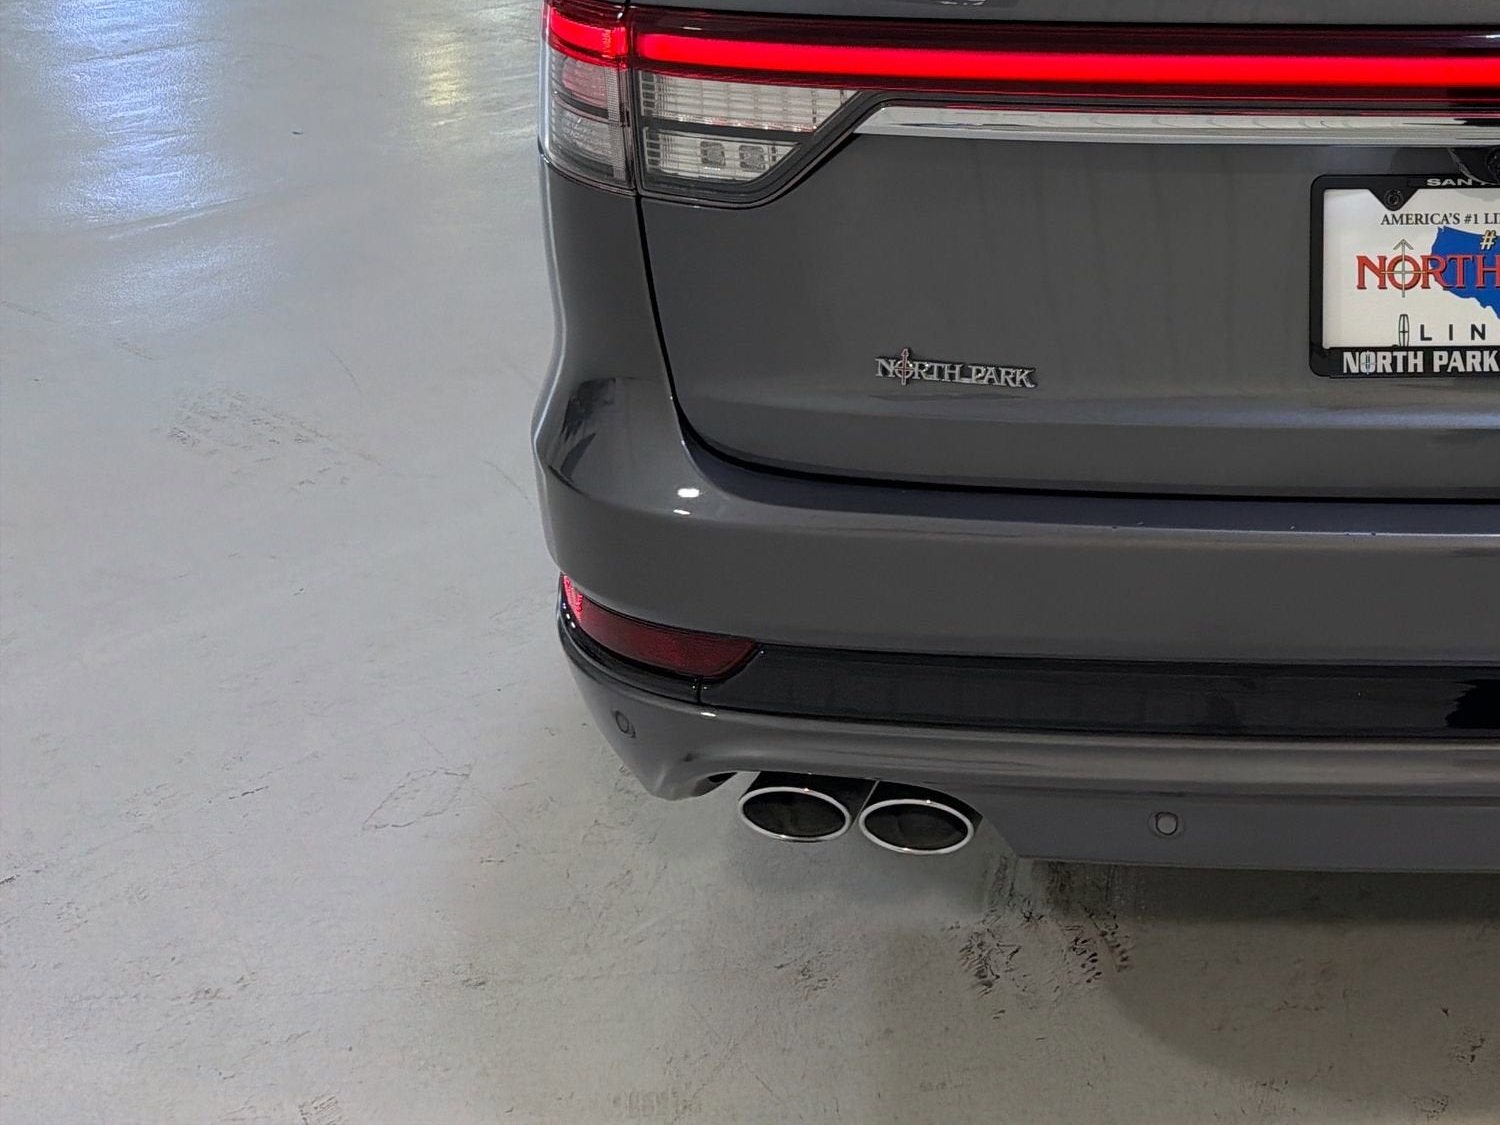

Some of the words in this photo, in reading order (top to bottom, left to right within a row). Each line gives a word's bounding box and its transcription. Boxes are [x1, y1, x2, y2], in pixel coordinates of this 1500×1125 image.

[1427, 178, 1473, 186] SAN
[1381, 212, 1461, 225] AMERICA'S
[1464, 213, 1478, 225] #1
[1343, 351, 1424, 374] NORTH
[1433, 350, 1500, 373] PARK
[875, 358, 964, 382] NORTH
[968, 365, 1036, 388] PARK
